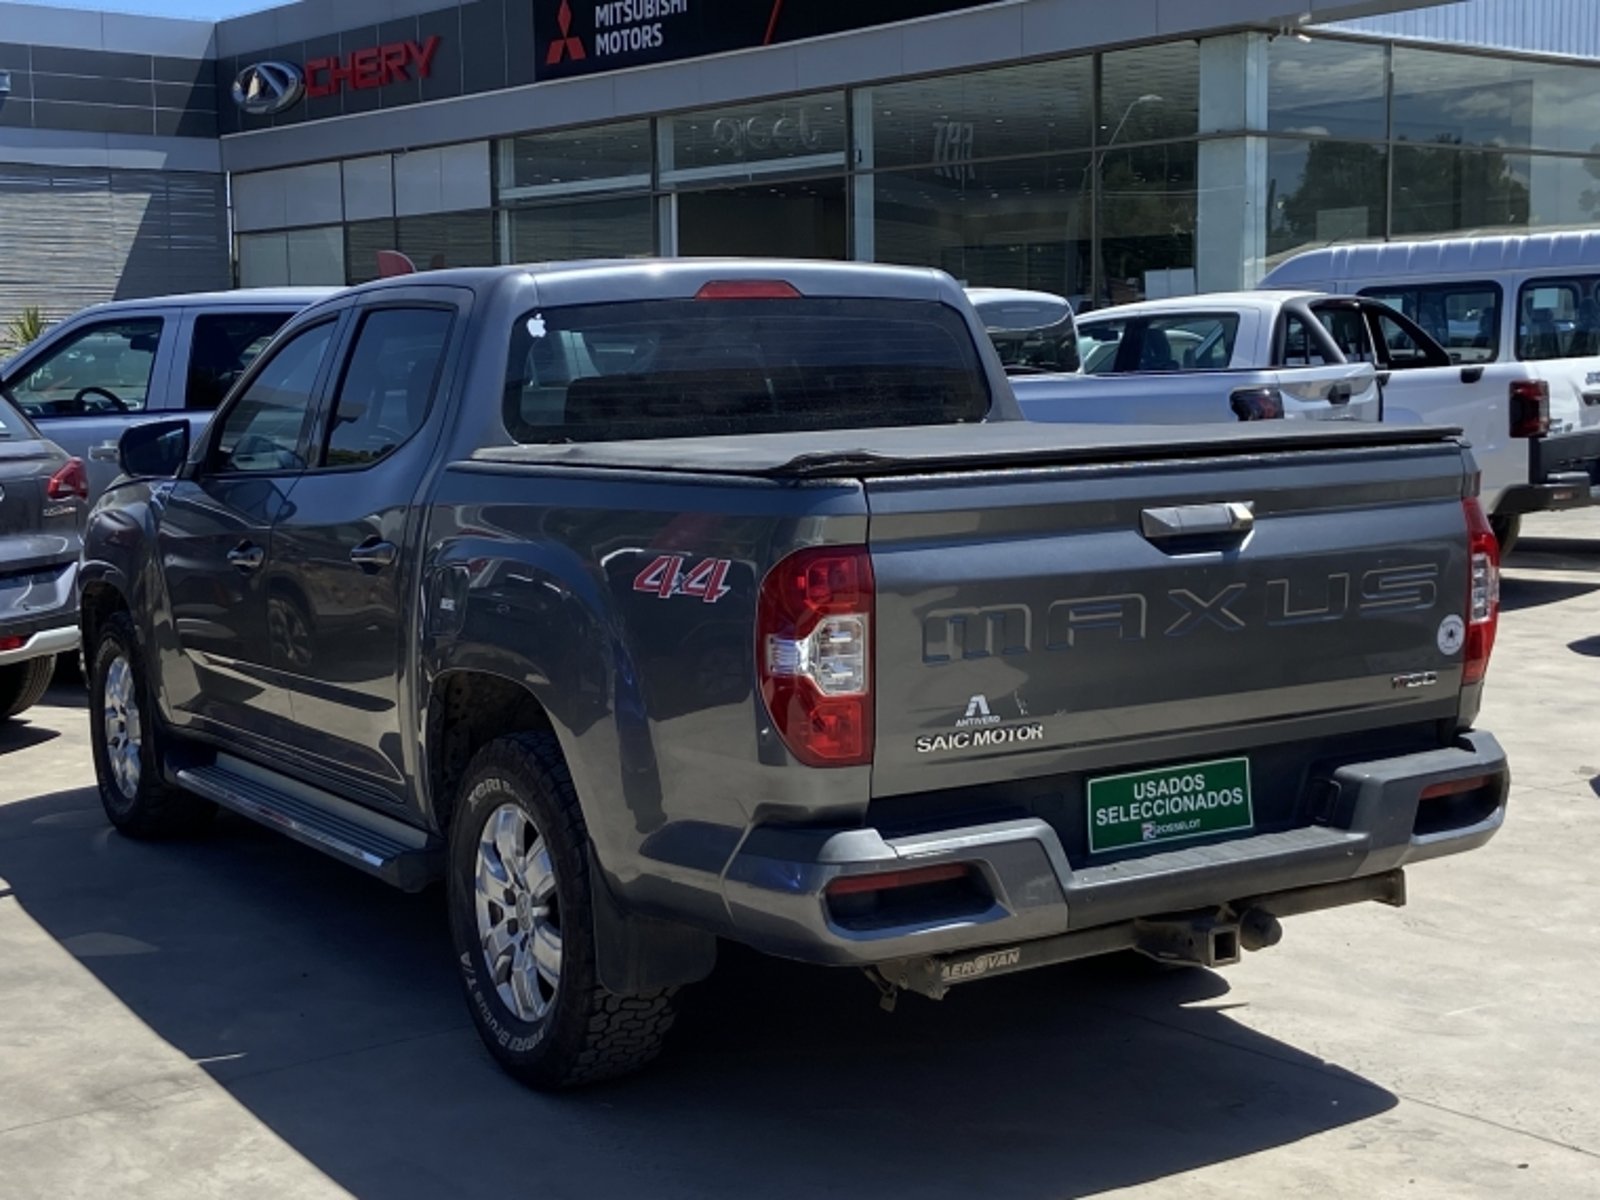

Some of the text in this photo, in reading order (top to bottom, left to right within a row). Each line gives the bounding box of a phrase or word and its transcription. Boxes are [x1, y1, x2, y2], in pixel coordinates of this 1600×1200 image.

[595, 0, 688, 28] MITSUBISHI
[595, 23, 664, 56] MOTORS
[305, 35, 441, 97] CHERY
[922, 563, 1439, 666] MAXUS
[915, 725, 1043, 753] SAIC MOTOR
[1134, 774, 1205, 800] USADOS
[1096, 787, 1243, 826] SELECCIONADOS
